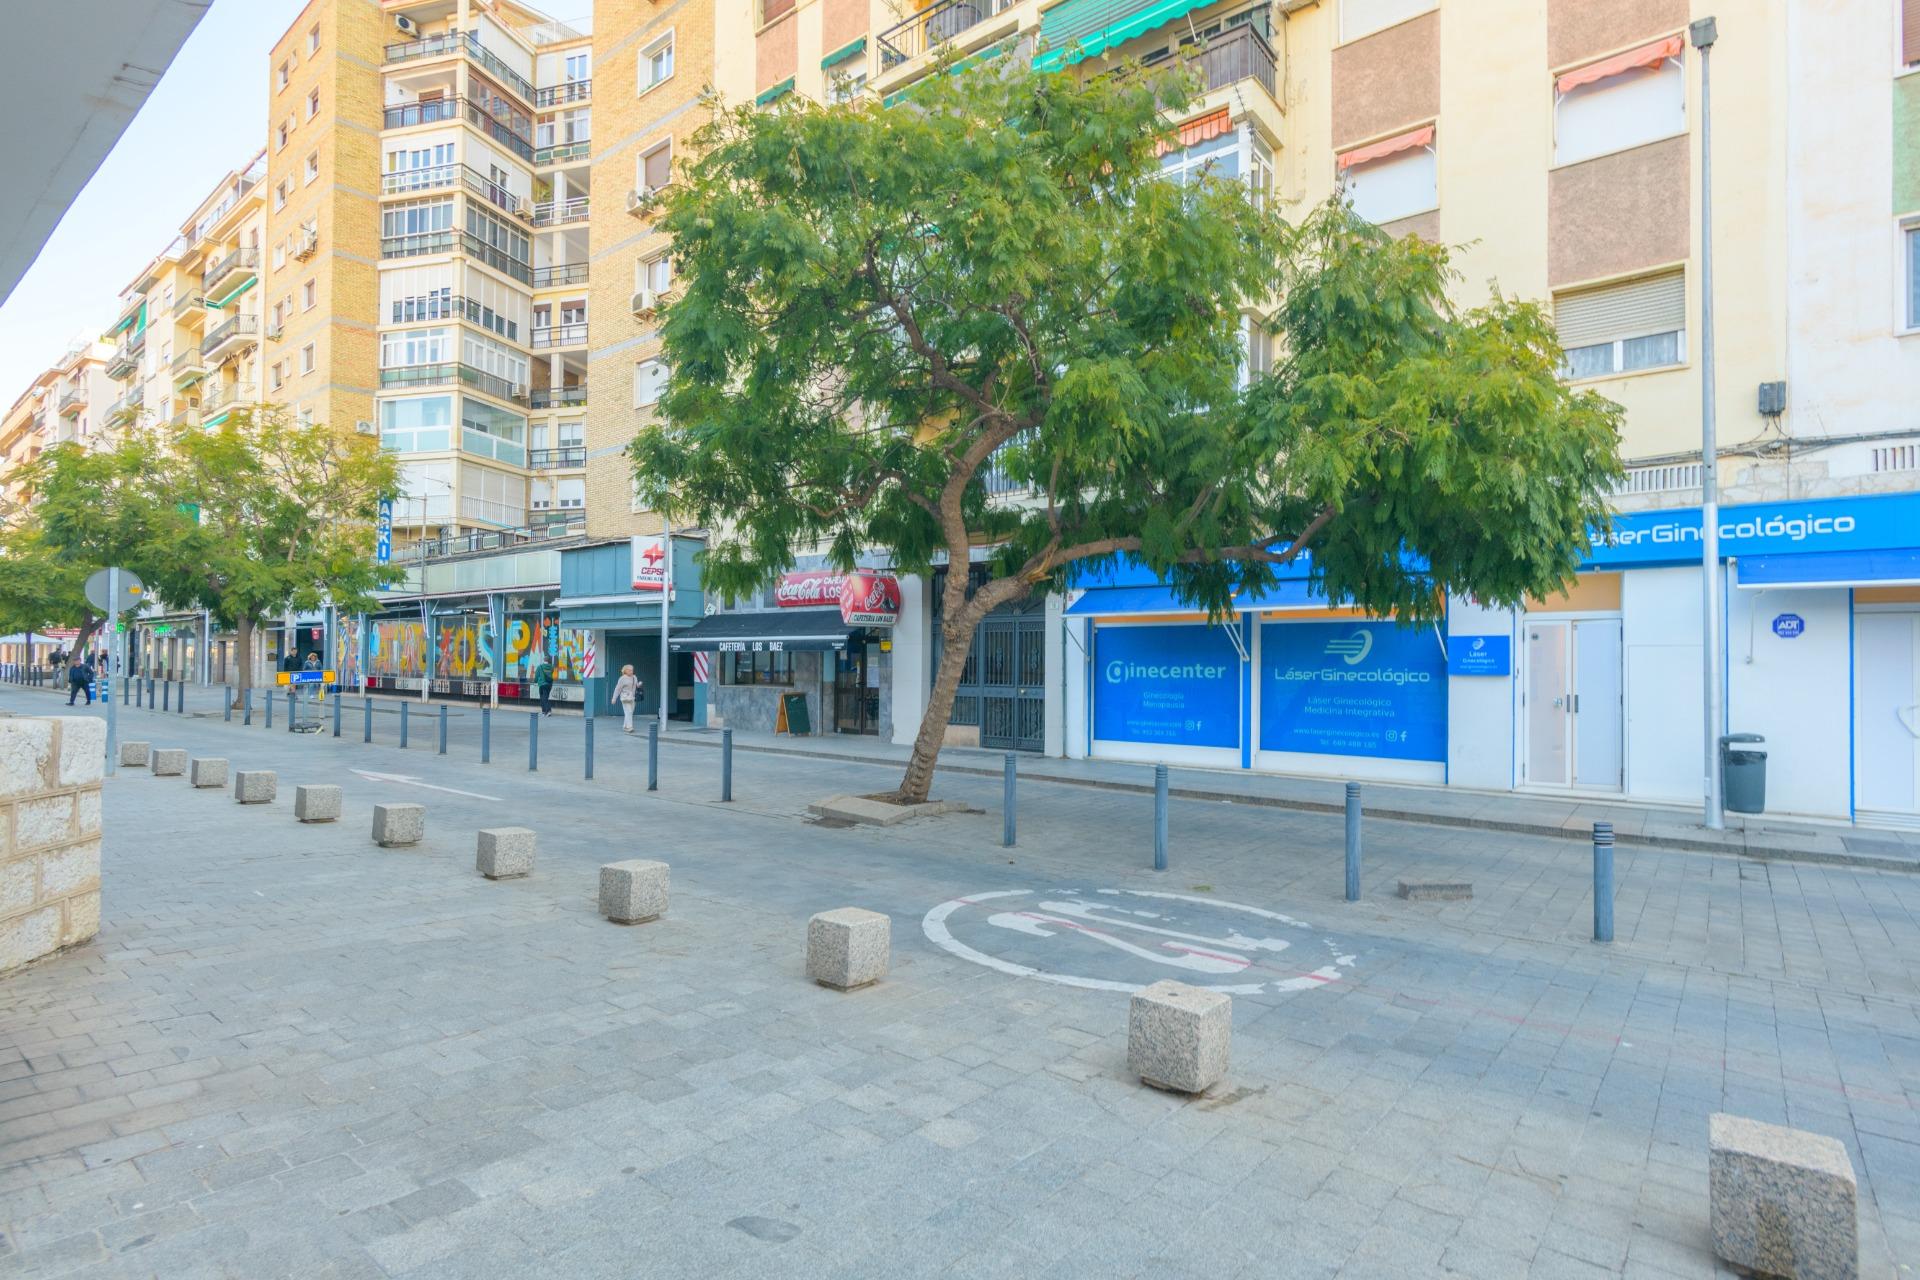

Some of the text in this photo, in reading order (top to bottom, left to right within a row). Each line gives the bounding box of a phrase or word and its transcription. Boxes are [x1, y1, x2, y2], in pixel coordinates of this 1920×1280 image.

[1778, 620, 1799, 630] ADT
[719, 641, 783, 651] CAFETERÍA LOS BAEZ
[1307, 696, 1332, 705] Láser
[1304, 706, 1395, 718] Medicina Integrativa
